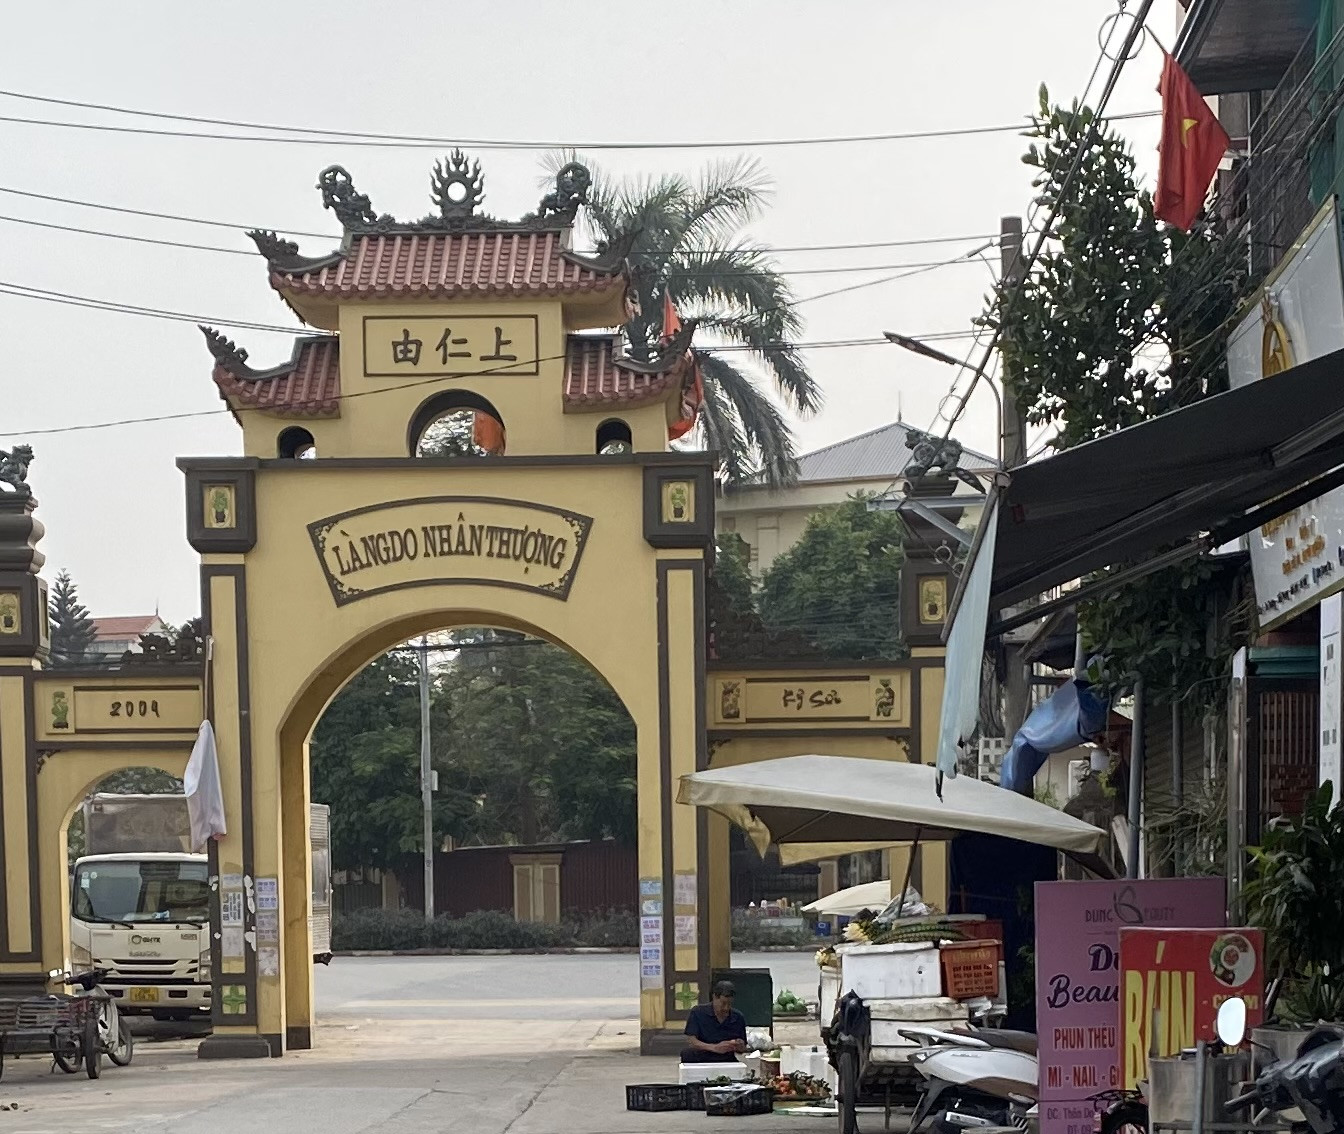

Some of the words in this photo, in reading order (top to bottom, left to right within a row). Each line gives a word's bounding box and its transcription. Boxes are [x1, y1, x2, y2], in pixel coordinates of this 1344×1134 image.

[391, 326, 518, 367] 由仁上
[1054, 1027, 1084, 1049] PHUN
[1072, 1065, 1098, 1087] NAIL
